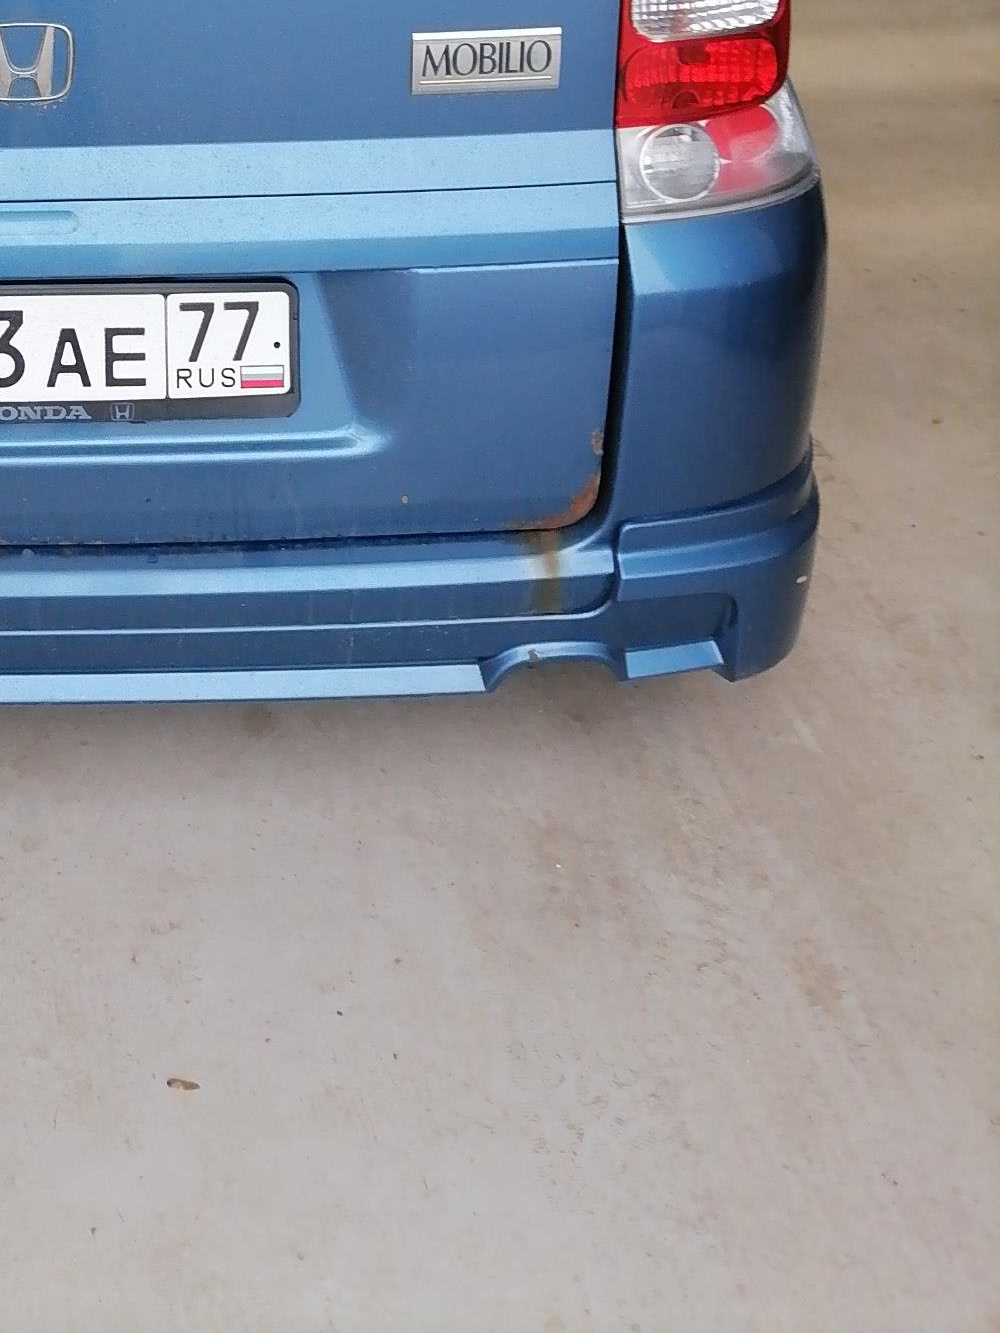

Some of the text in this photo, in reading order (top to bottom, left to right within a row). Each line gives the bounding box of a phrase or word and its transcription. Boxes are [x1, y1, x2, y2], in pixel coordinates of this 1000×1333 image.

[421, 39, 552, 77] MOBILIO
[179, 302, 259, 362] 77
[176, 367, 236, 389] RUS
